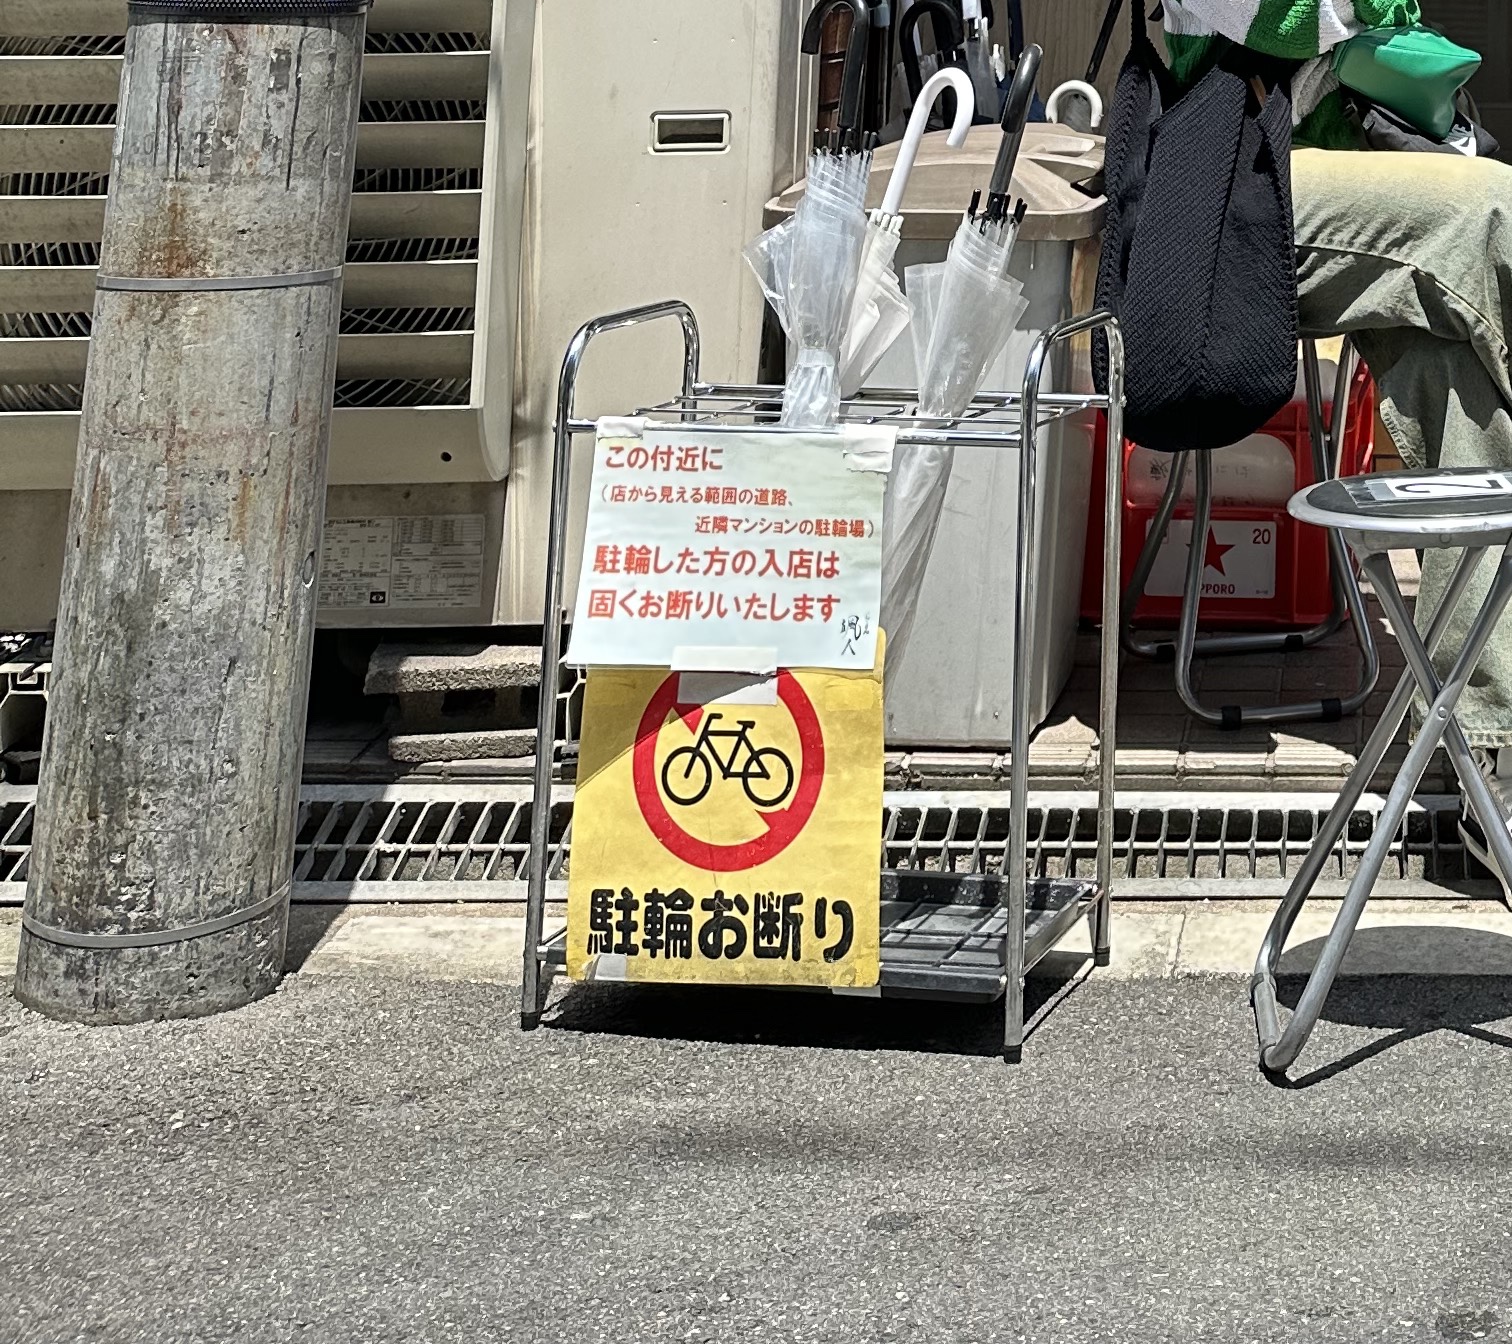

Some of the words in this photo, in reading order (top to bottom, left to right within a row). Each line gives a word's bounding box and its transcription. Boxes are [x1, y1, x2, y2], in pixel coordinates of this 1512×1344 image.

[604, 444, 724, 472] この付近に
[1252, 528, 1271, 545] 20
[592, 544, 841, 580] 駐輪した方の入店は
[586, 588, 842, 624] 固くお断りいたします
[586, 886, 854, 963] 駐輪お断り
